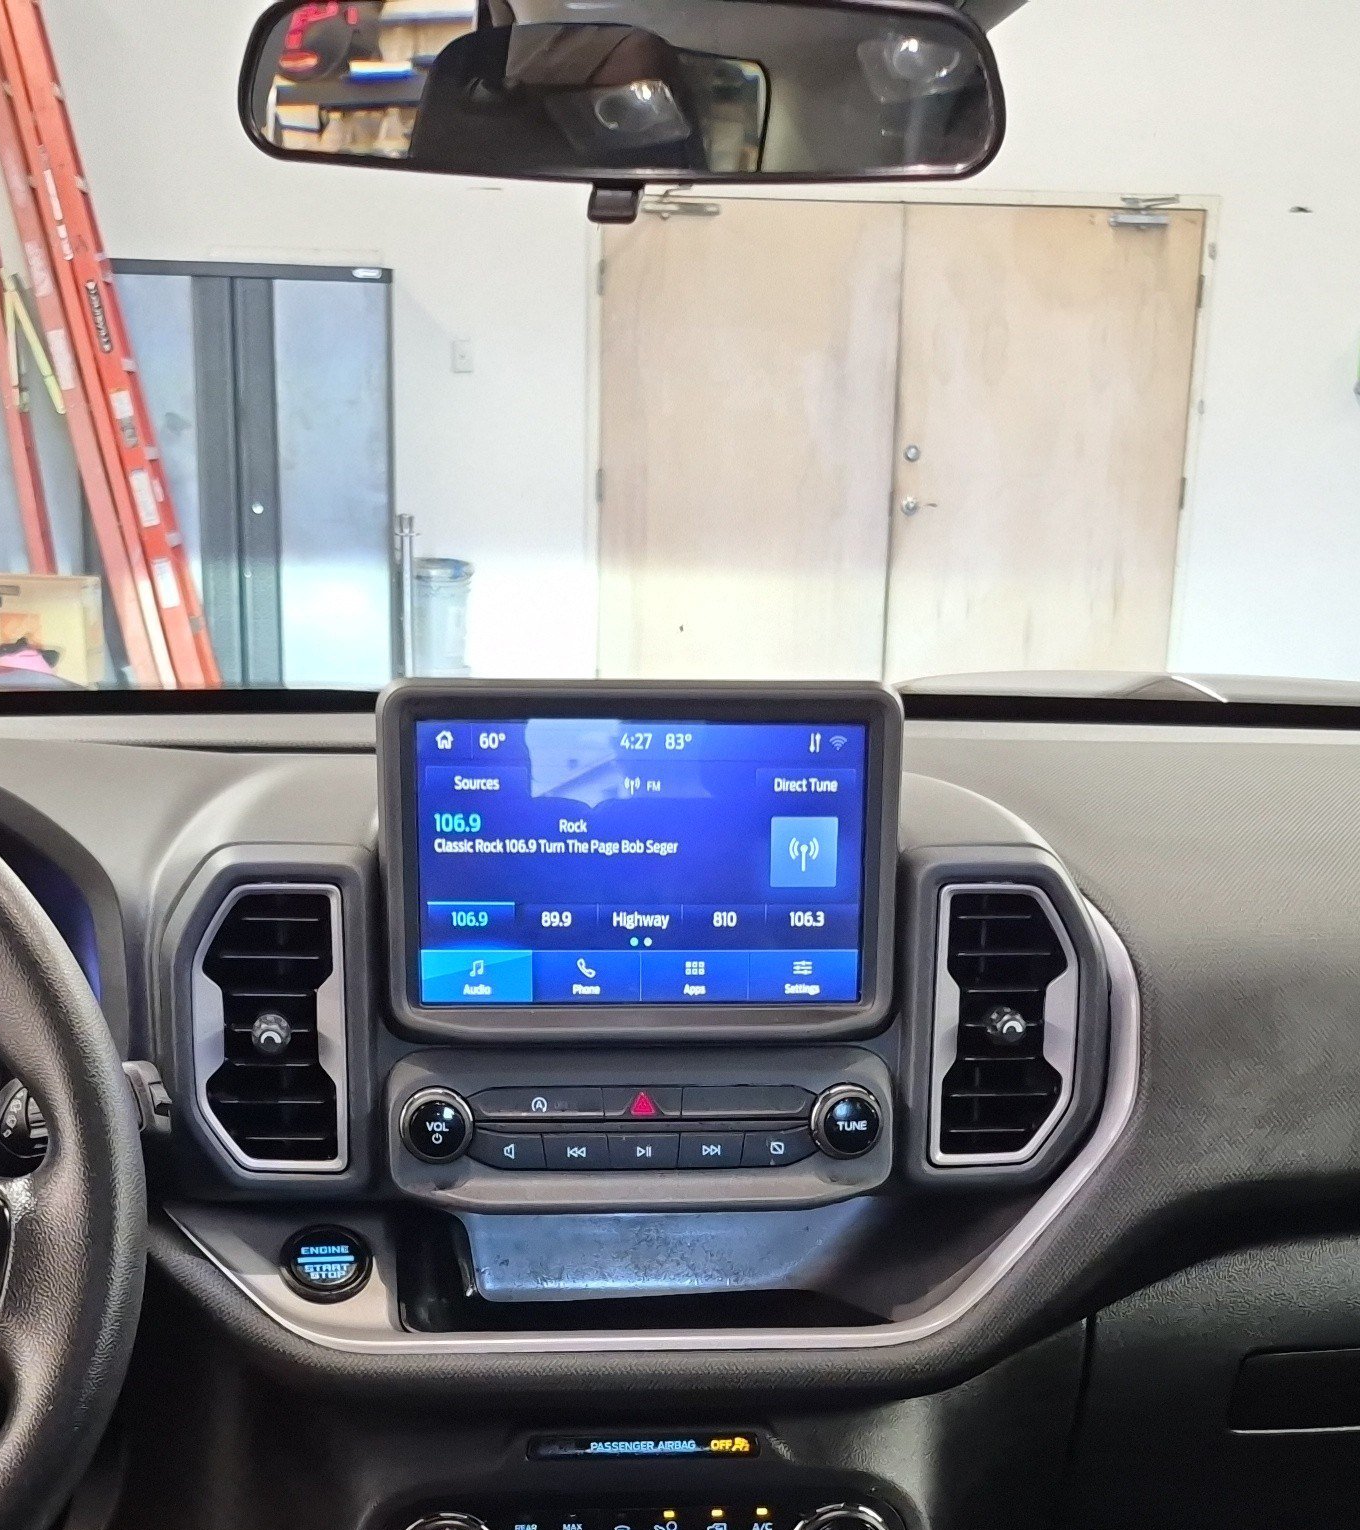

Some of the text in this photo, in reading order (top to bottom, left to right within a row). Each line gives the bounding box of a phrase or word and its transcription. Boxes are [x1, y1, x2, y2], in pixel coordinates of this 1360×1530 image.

[478, 732, 506, 749] 60°
[620, 733, 693, 750] 4:27 83°
[454, 775, 500, 792] Sources
[646, 781, 661, 792] FM
[774, 778, 838, 793] Direct Tune
[434, 813, 481, 832] 106.9
[559, 819, 587, 833] Rock
[434, 839, 678, 858] Classic Rock 106.9 Turn The Page Bob Seger
[451, 911, 488, 928] 106.9
[541, 912, 571, 928] 89.9
[612, 911, 669, 930] Highway
[712, 912, 737, 928] 810
[789, 912, 824, 928] 106.3
[463, 984, 491, 996] Audio
[572, 984, 600, 995] Phone
[683, 984, 705, 997] Apps
[784, 983, 820, 997] Settings
[426, 1121, 449, 1133] VOL
[837, 1120, 867, 1132] TUNE
[301, 1245, 349, 1254] ENGINE
[304, 1263, 350, 1272] START
[310, 1271, 346, 1279] STOP
[590, 1439, 732, 1452] PASSENGER AIRBAG OFF
